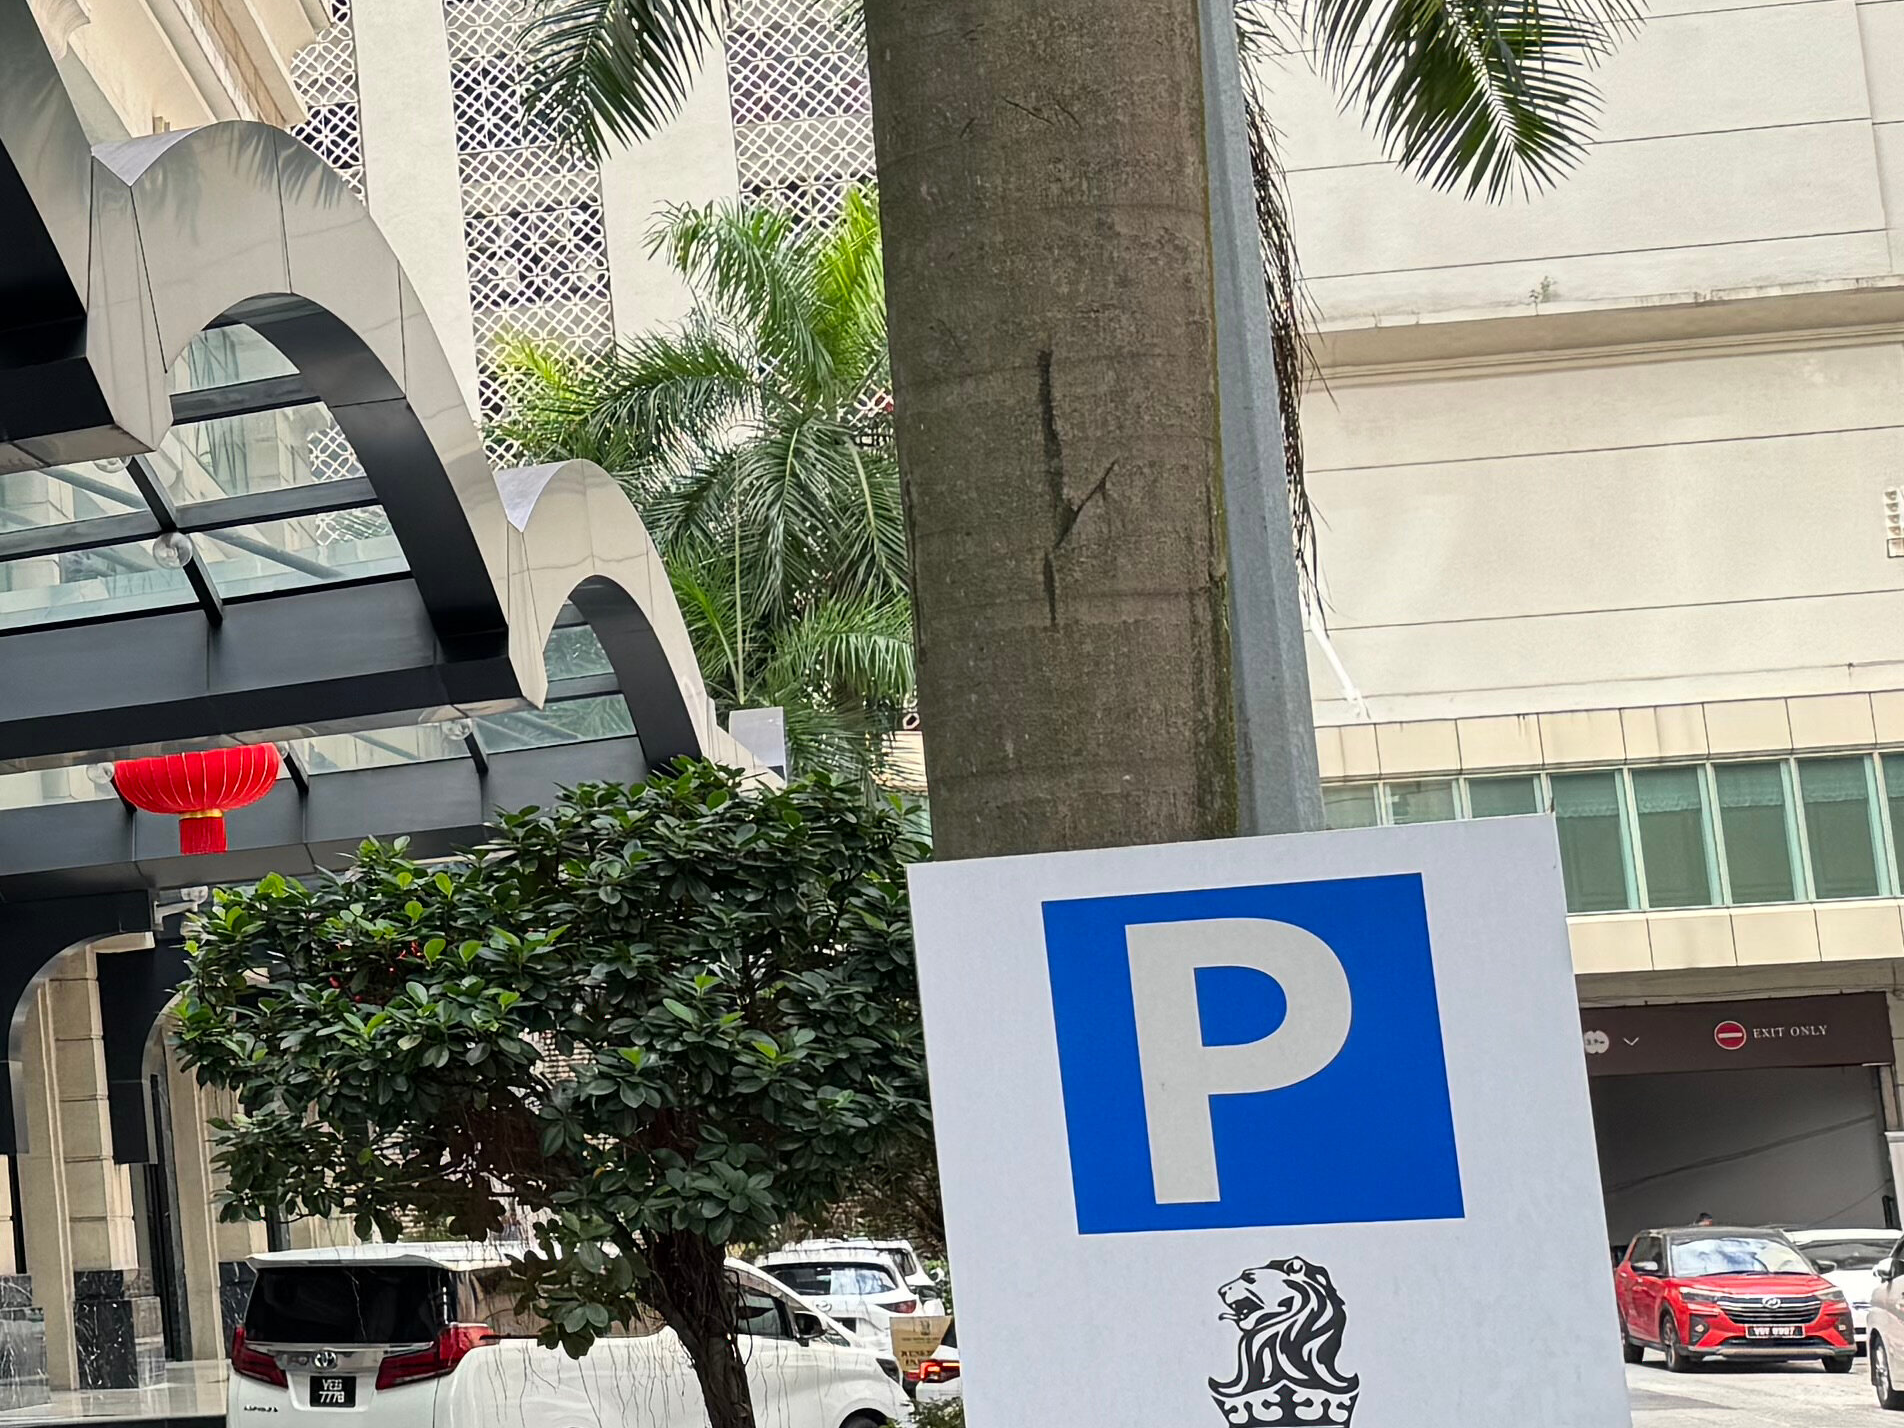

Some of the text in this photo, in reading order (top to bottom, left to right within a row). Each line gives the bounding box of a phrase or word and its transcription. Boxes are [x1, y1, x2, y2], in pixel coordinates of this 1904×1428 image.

[1125, 917, 1352, 1204] P
[1753, 1024, 1828, 1039] EXIT ONLY
